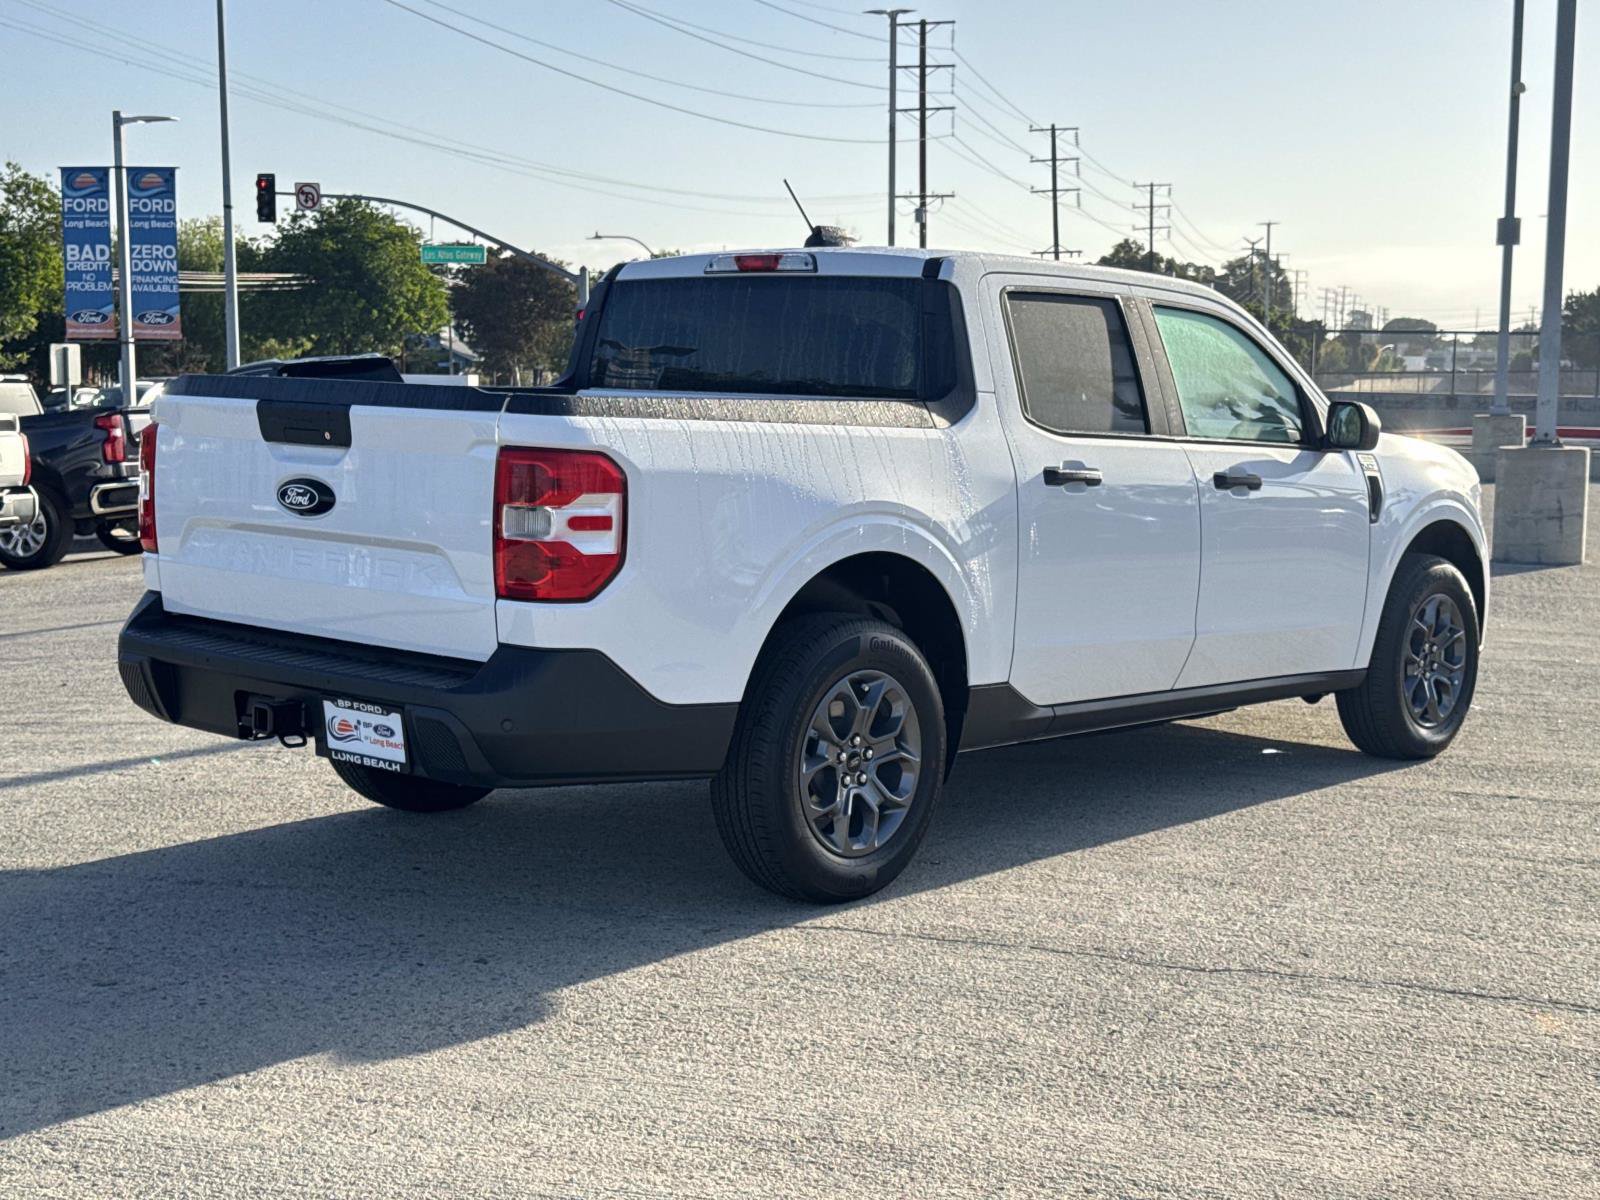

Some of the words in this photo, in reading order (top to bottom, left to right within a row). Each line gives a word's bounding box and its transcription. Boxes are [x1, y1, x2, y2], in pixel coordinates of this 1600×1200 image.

[64, 198, 108, 212] FORD
[130, 198, 175, 212] FORD
[64, 220, 84, 229] Long
[85, 219, 109, 228] Beach
[130, 220, 149, 229] Long
[151, 220, 175, 228] Beach
[66, 244, 110, 261] BAD
[131, 244, 176, 259] ZERO
[66, 261, 110, 271] CREDIT?
[131, 259, 177, 272] DOWN
[82, 273, 96, 281] NO
[131, 275, 178, 284] FINANCING
[66, 281, 112, 291] PROBLEM
[131, 284, 178, 293] AVAILABLE
[78, 312, 102, 323] Ford
[143, 312, 168, 324] Ford
[285, 487, 310, 505] Ford
[337, 699, 352, 708] BP
[353, 702, 382, 714] FORD
[376, 726, 391, 736] Ford
[369, 737, 385, 748] Long
[385, 740, 404, 750] Beach
[331, 751, 362, 765] LONG
[362, 757, 401, 772] BEACH
